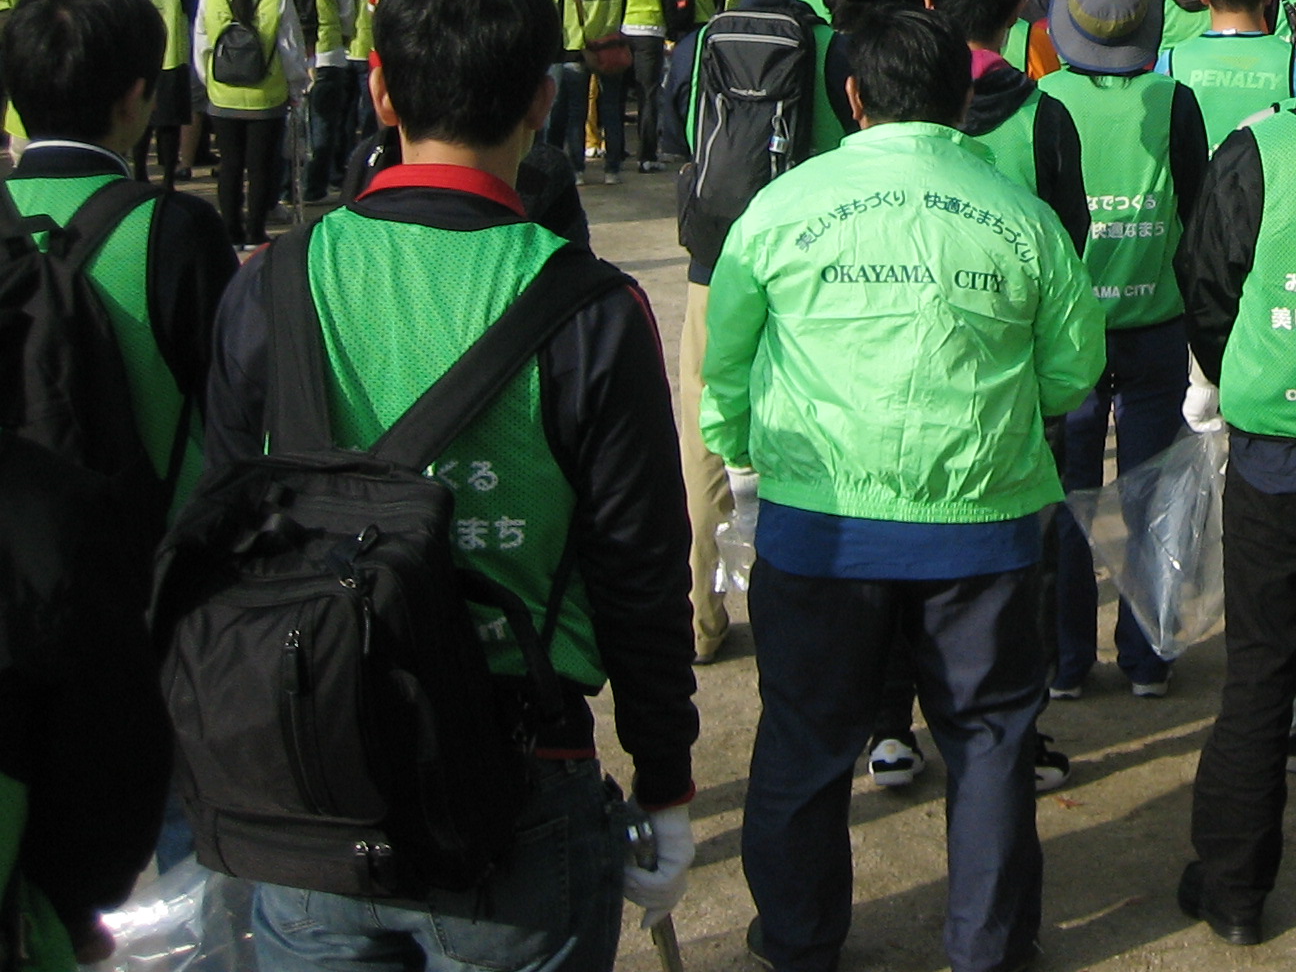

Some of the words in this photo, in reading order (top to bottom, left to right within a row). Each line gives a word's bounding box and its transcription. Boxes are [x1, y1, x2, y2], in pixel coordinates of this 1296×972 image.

[1189, 69, 1284, 90] PENALTY
[794, 190, 906, 252] 美しいまちづくり
[924, 191, 1035, 263] 快適なまちづくり
[821, 264, 937, 284] OKAYAMA
[954, 268, 1004, 294] CITY
[1124, 283, 1156, 297] CITY
[456, 515, 527, 550] まち
